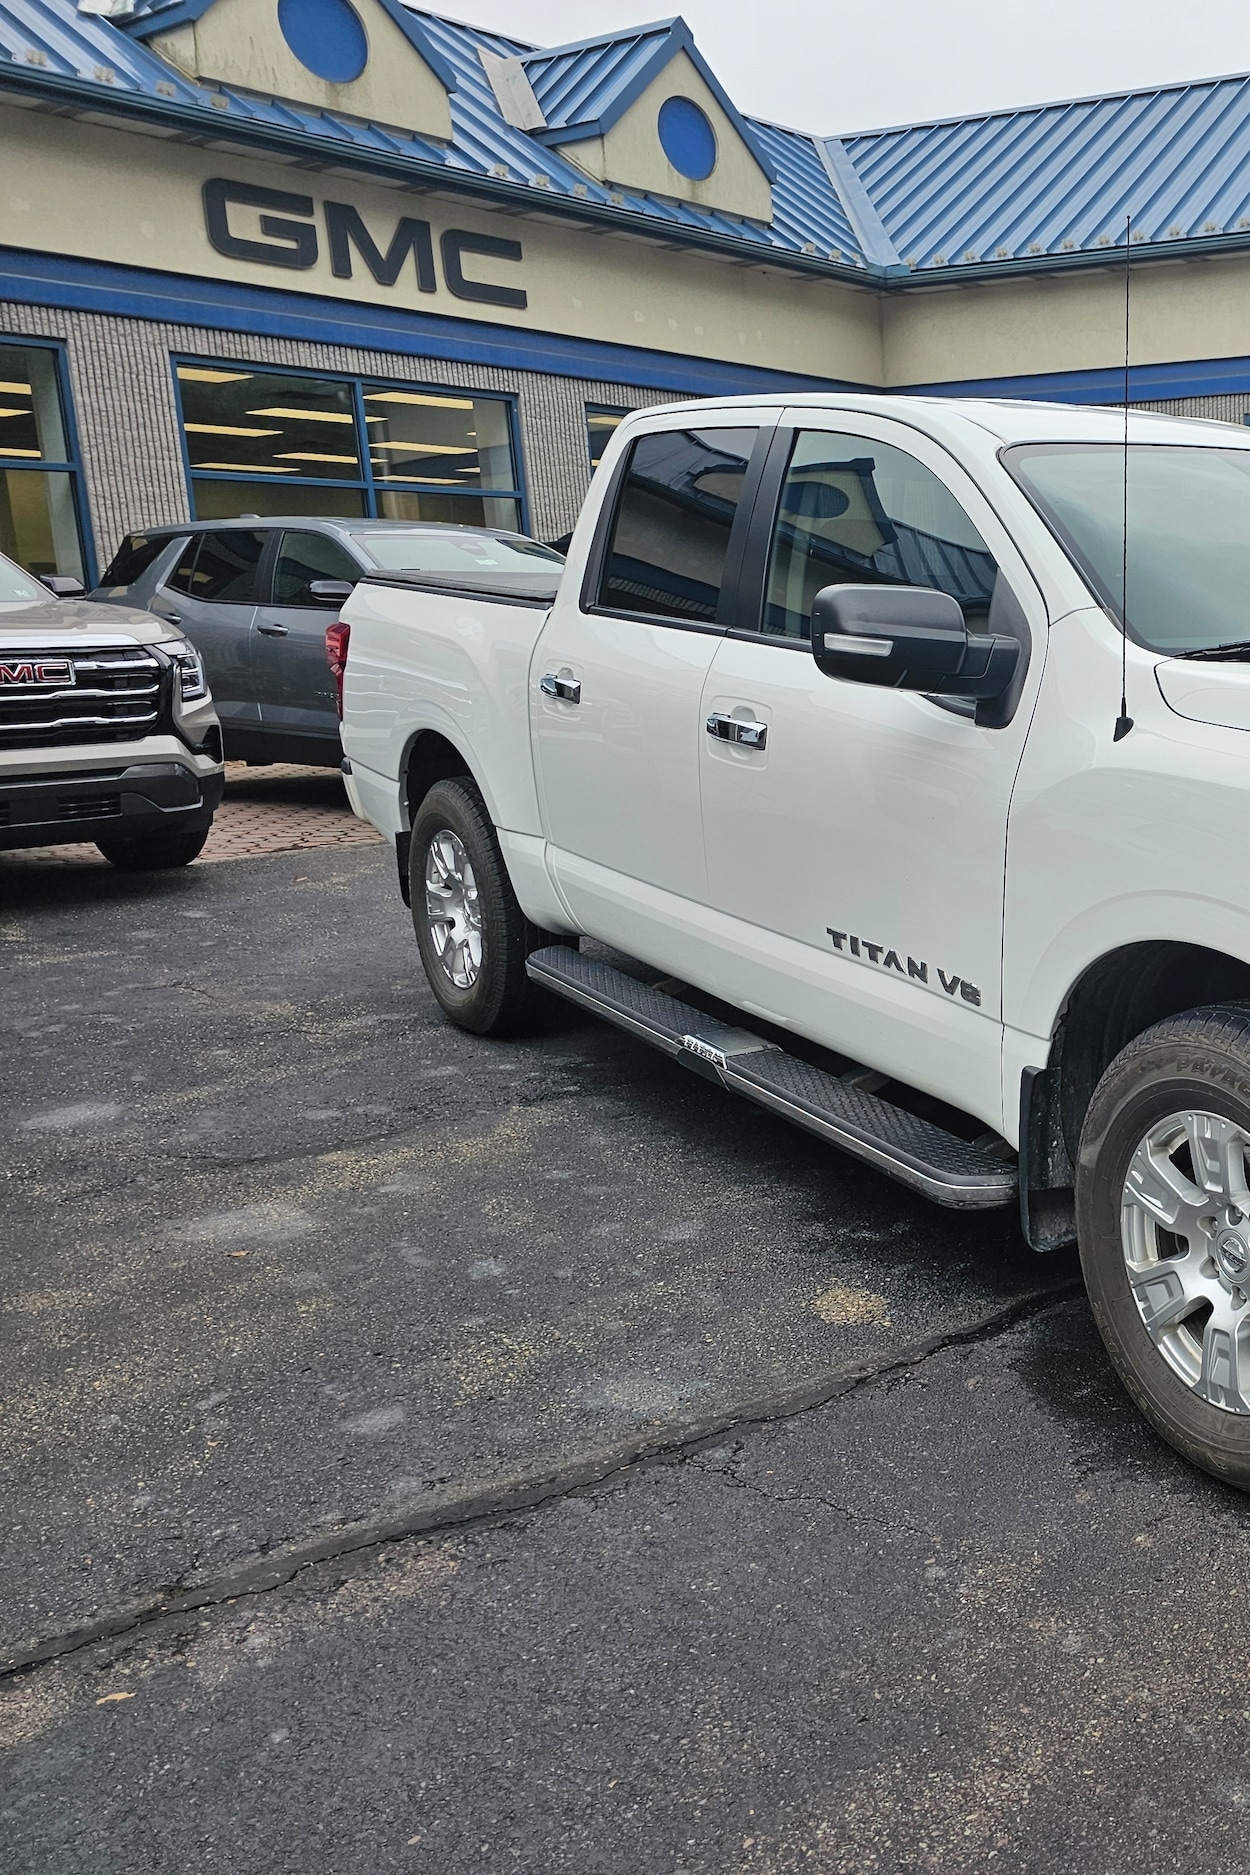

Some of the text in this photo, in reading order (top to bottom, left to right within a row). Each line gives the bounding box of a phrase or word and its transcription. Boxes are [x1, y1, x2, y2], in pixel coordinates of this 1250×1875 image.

[202, 178, 527, 309] GMC
[0, 663, 70, 684] MC
[826, 926, 982, 1007] TITAN V8
